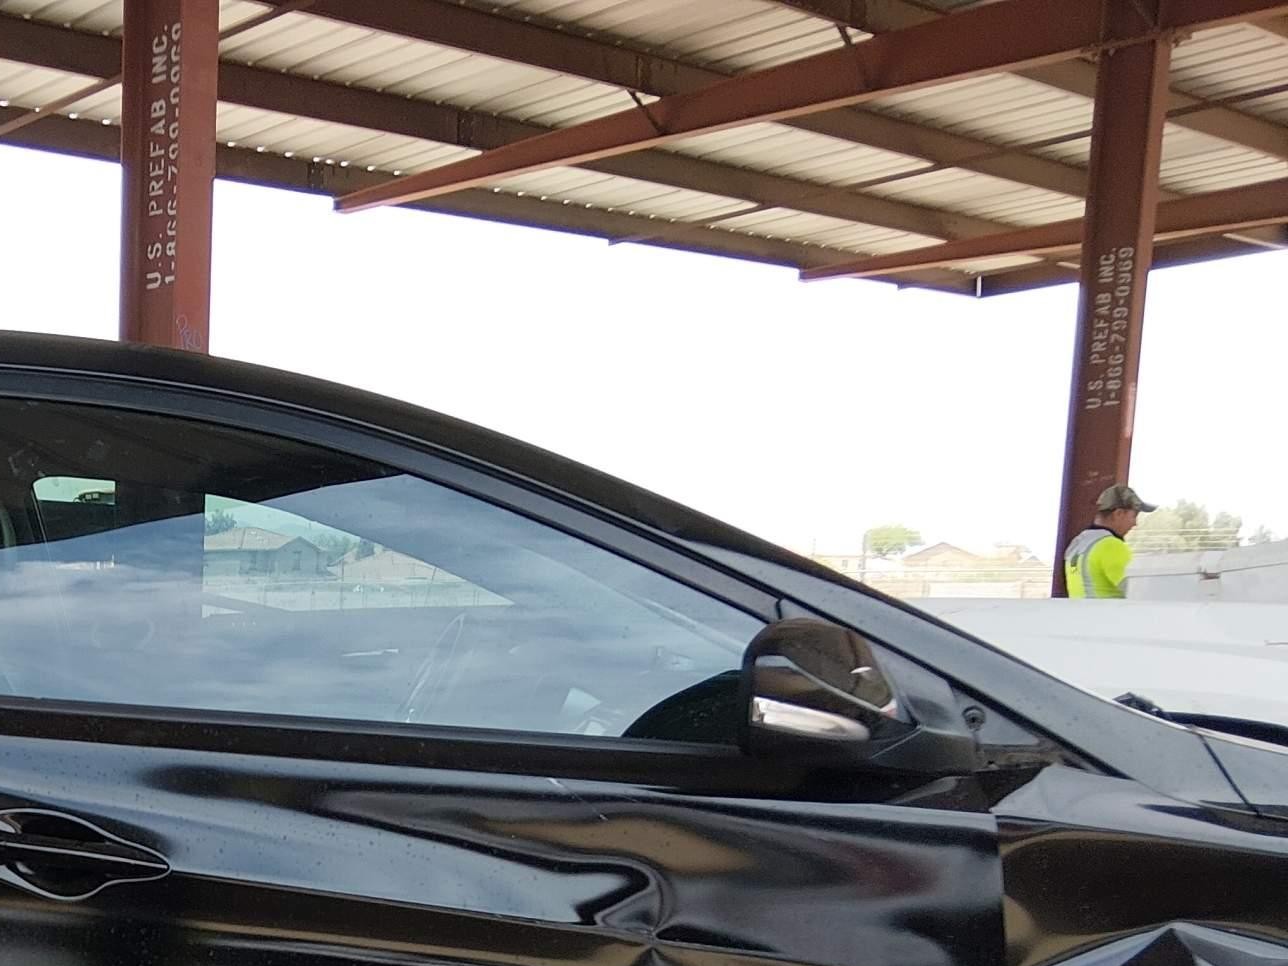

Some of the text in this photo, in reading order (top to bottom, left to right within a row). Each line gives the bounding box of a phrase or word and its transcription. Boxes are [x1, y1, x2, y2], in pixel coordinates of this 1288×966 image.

[146, 24, 168, 290] U.S. PREFAB INC.
[1085, 248, 1117, 410] U.S. PREFAB INC.
[1103, 246, 1134, 406] 1-866-799-0969
